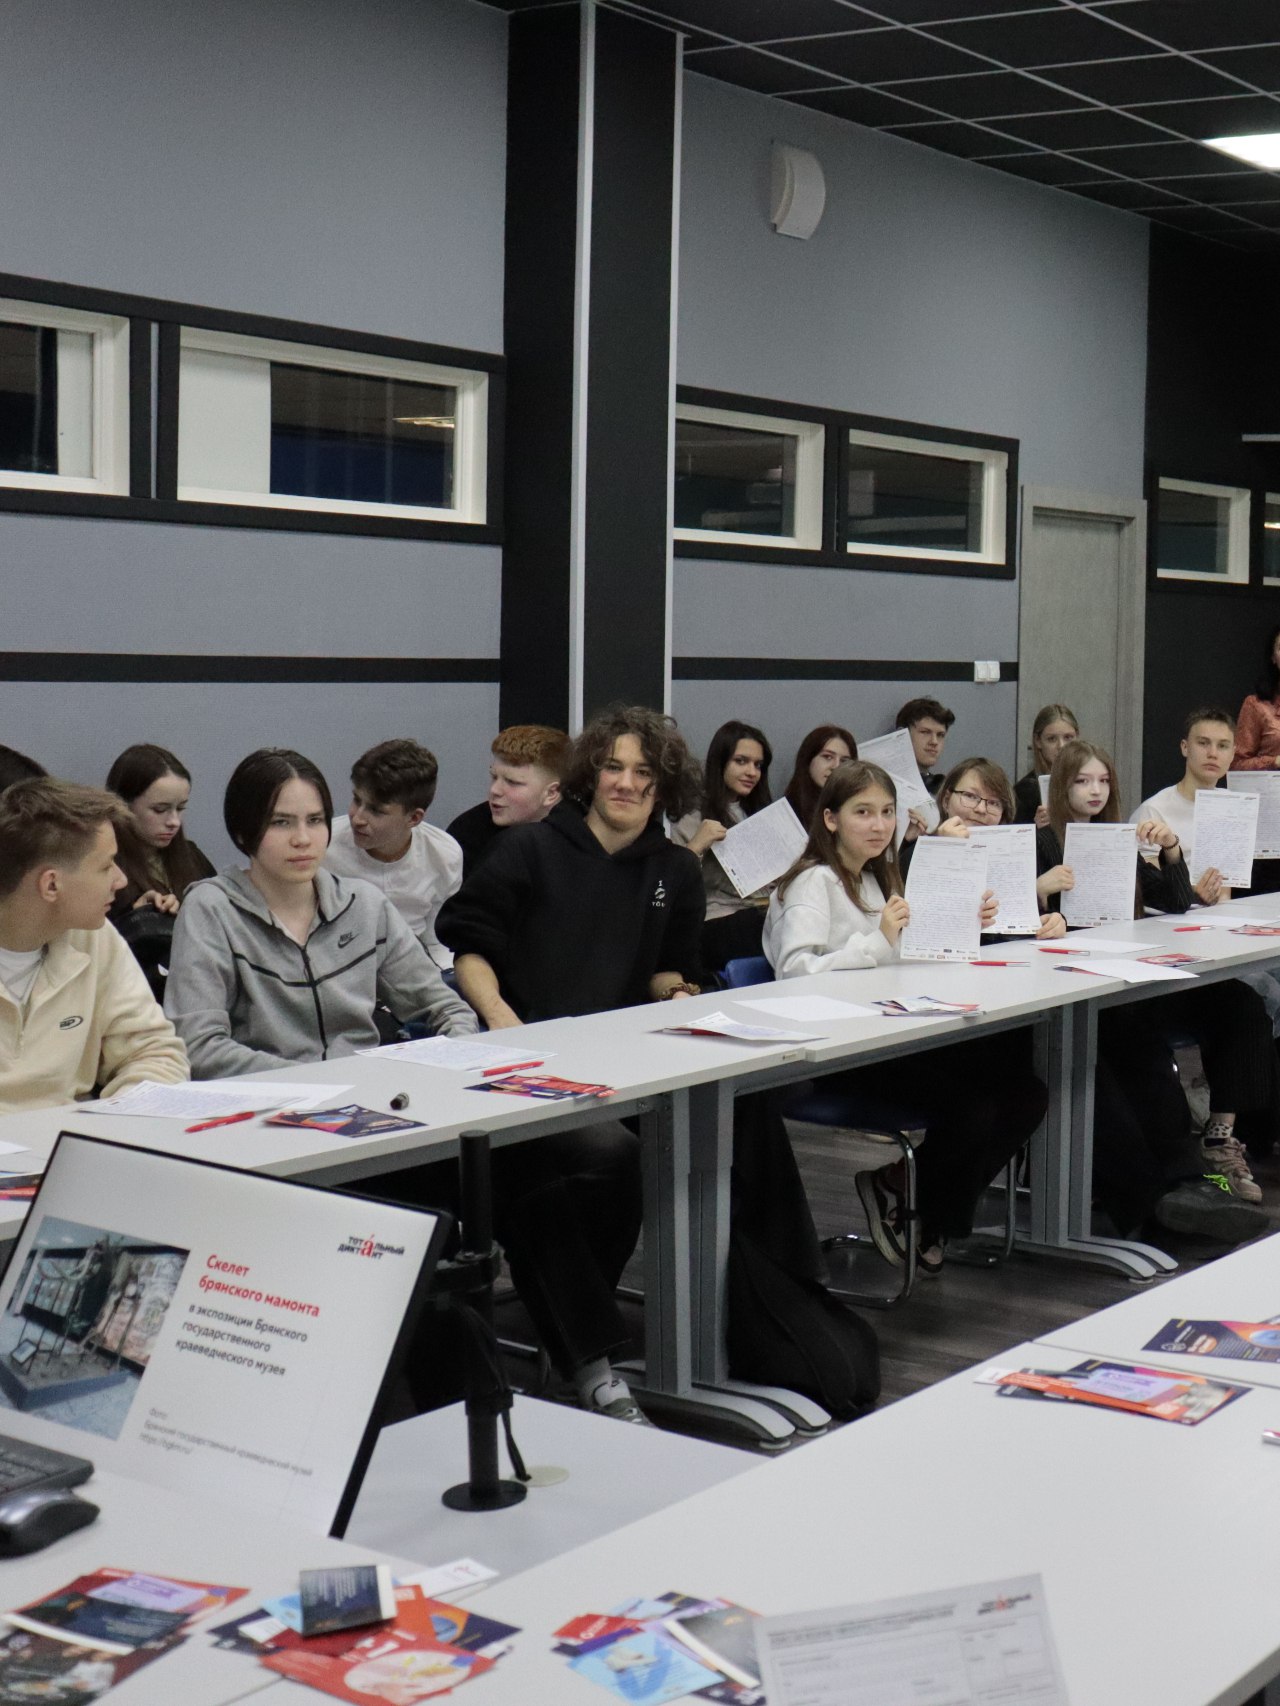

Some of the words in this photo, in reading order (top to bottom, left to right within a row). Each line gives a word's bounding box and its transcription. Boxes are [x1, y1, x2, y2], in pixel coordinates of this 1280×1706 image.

[207, 1254, 249, 1277] Скелет
[199, 1275, 262, 1302] брянского
[265, 1293, 320, 1317] мамонта
[182, 1321, 271, 1352] государственного
[196, 1306, 253, 1328] экспозиции
[254, 1319, 308, 1342] Брянского
[175, 1339, 253, 1368] краеведческого
[255, 1361, 286, 1376] музея
